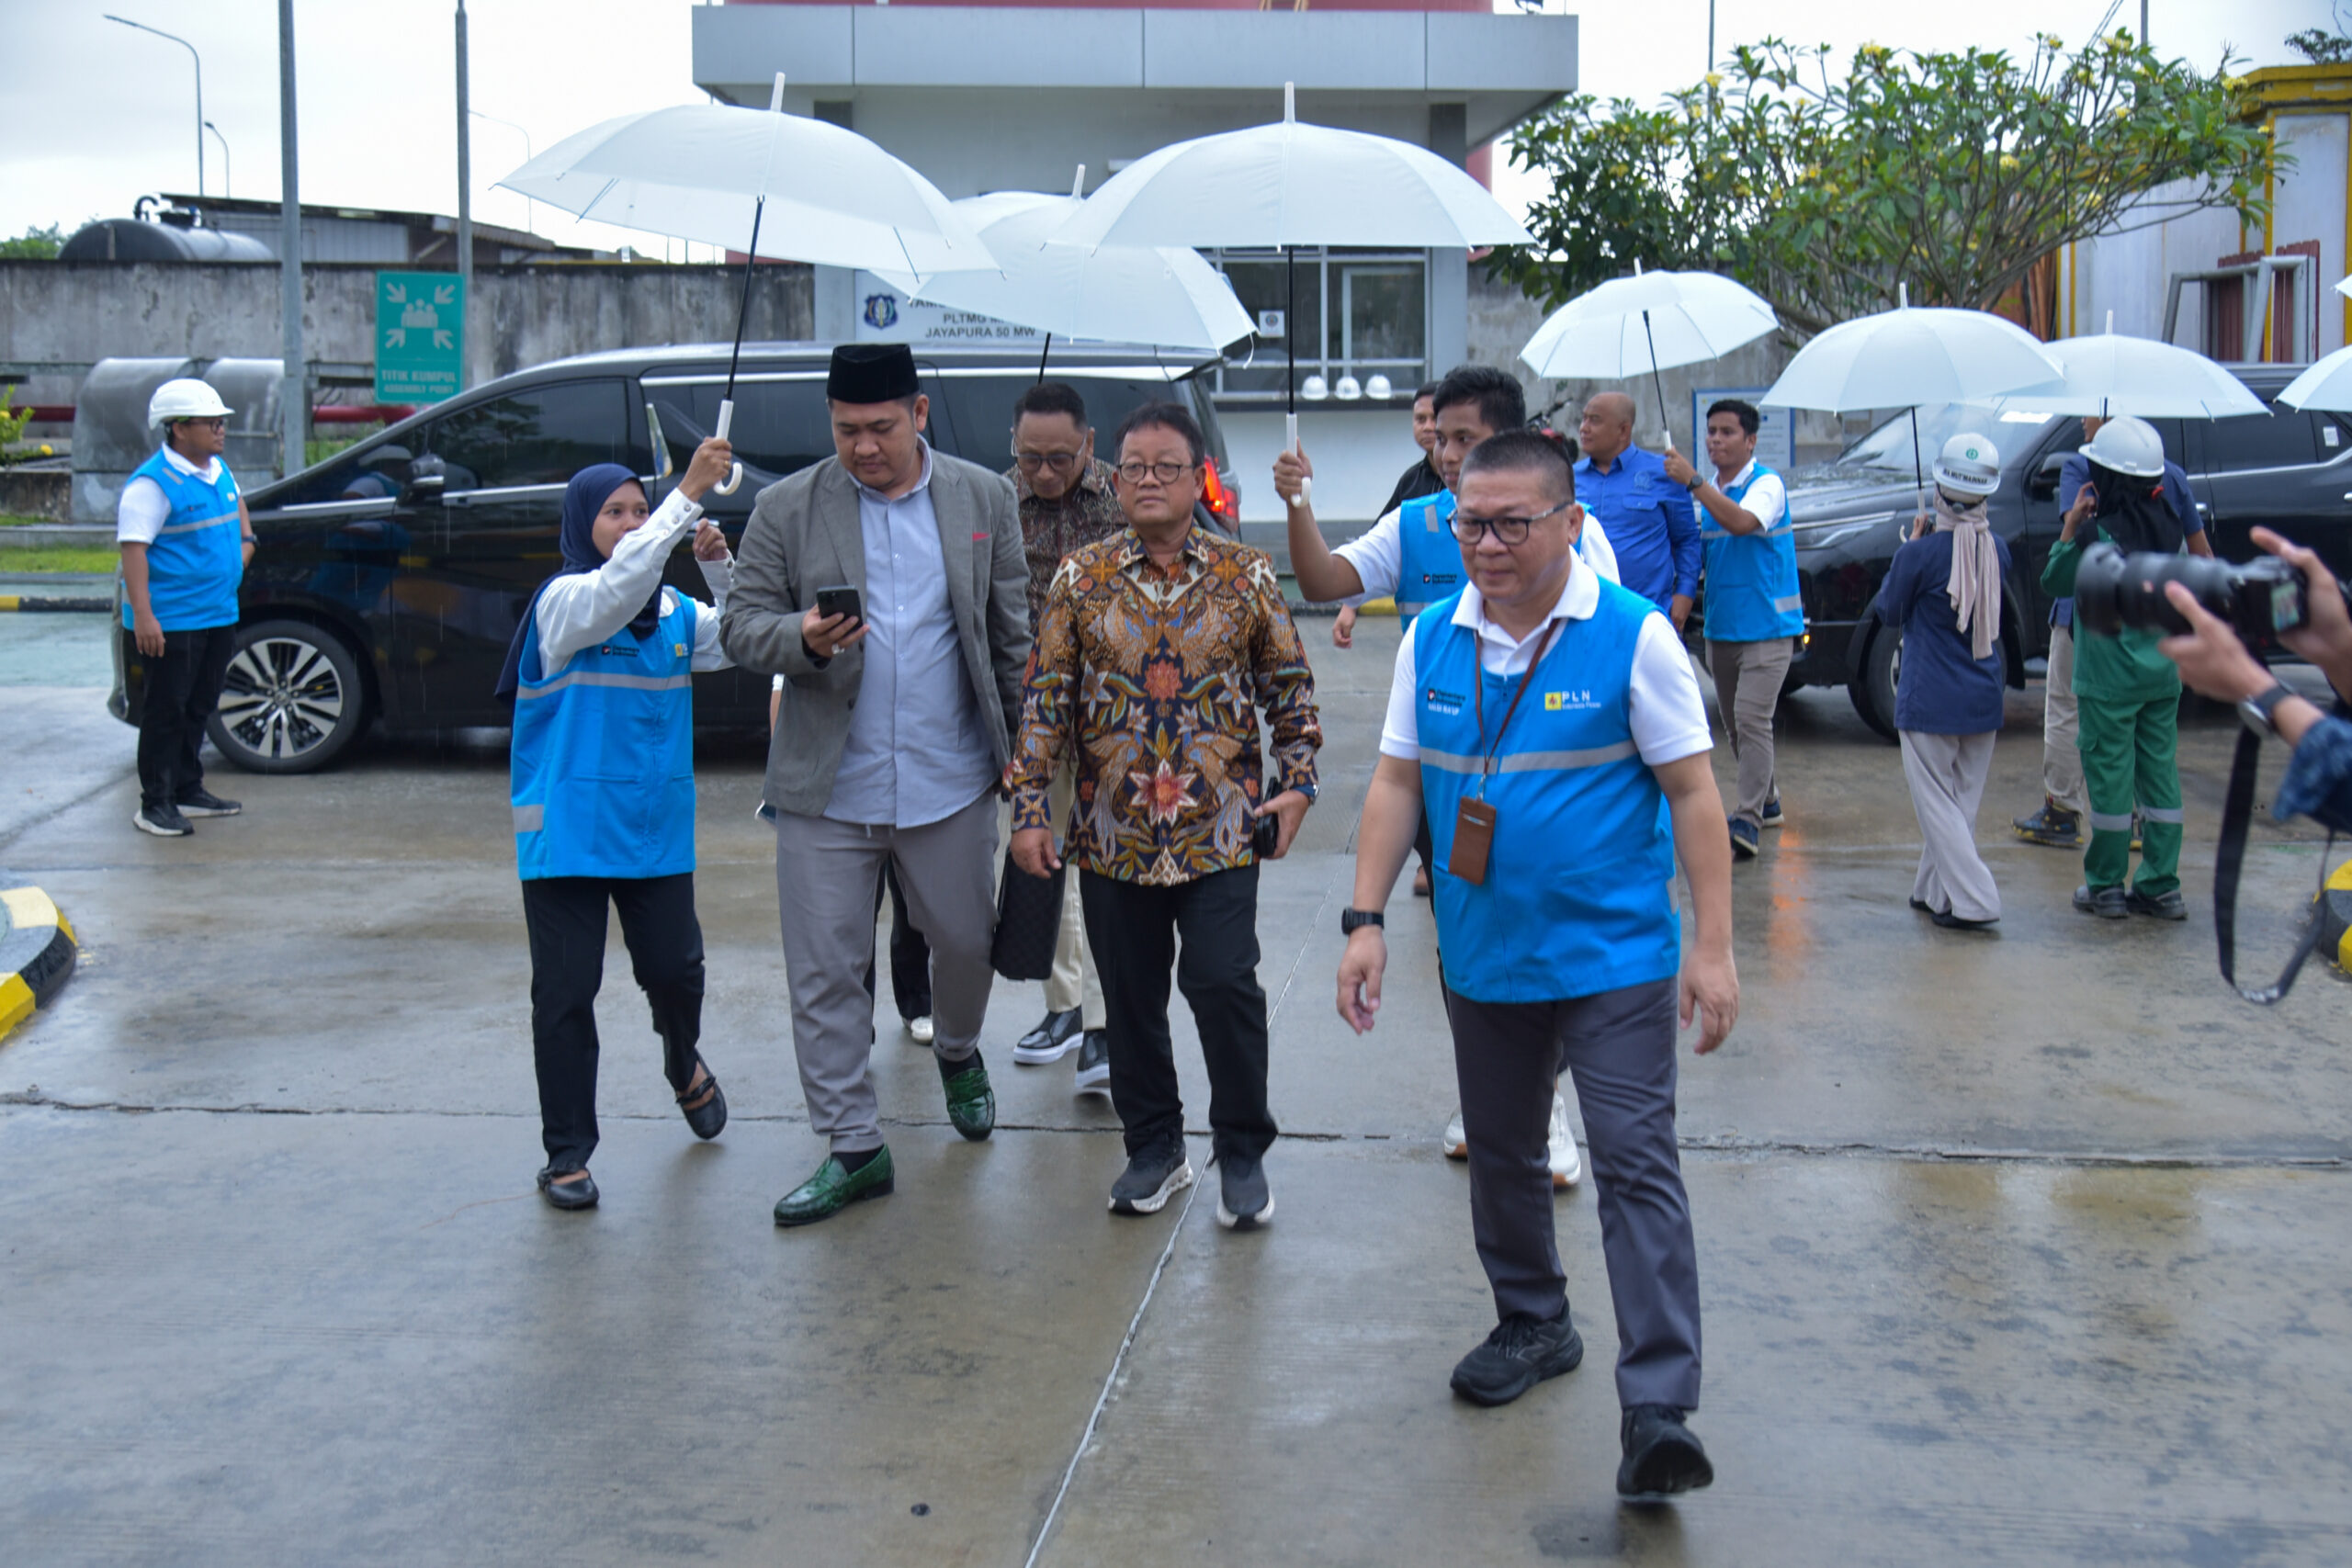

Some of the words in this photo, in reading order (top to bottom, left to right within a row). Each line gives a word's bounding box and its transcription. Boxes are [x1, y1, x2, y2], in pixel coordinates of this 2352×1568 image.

[925, 327, 993, 338] JAYAPURA
[996, 326, 1010, 337] 50
[1013, 326, 1035, 337] MW
[382, 370, 409, 381] TITIK
[412, 371, 457, 382] KUMPUL
